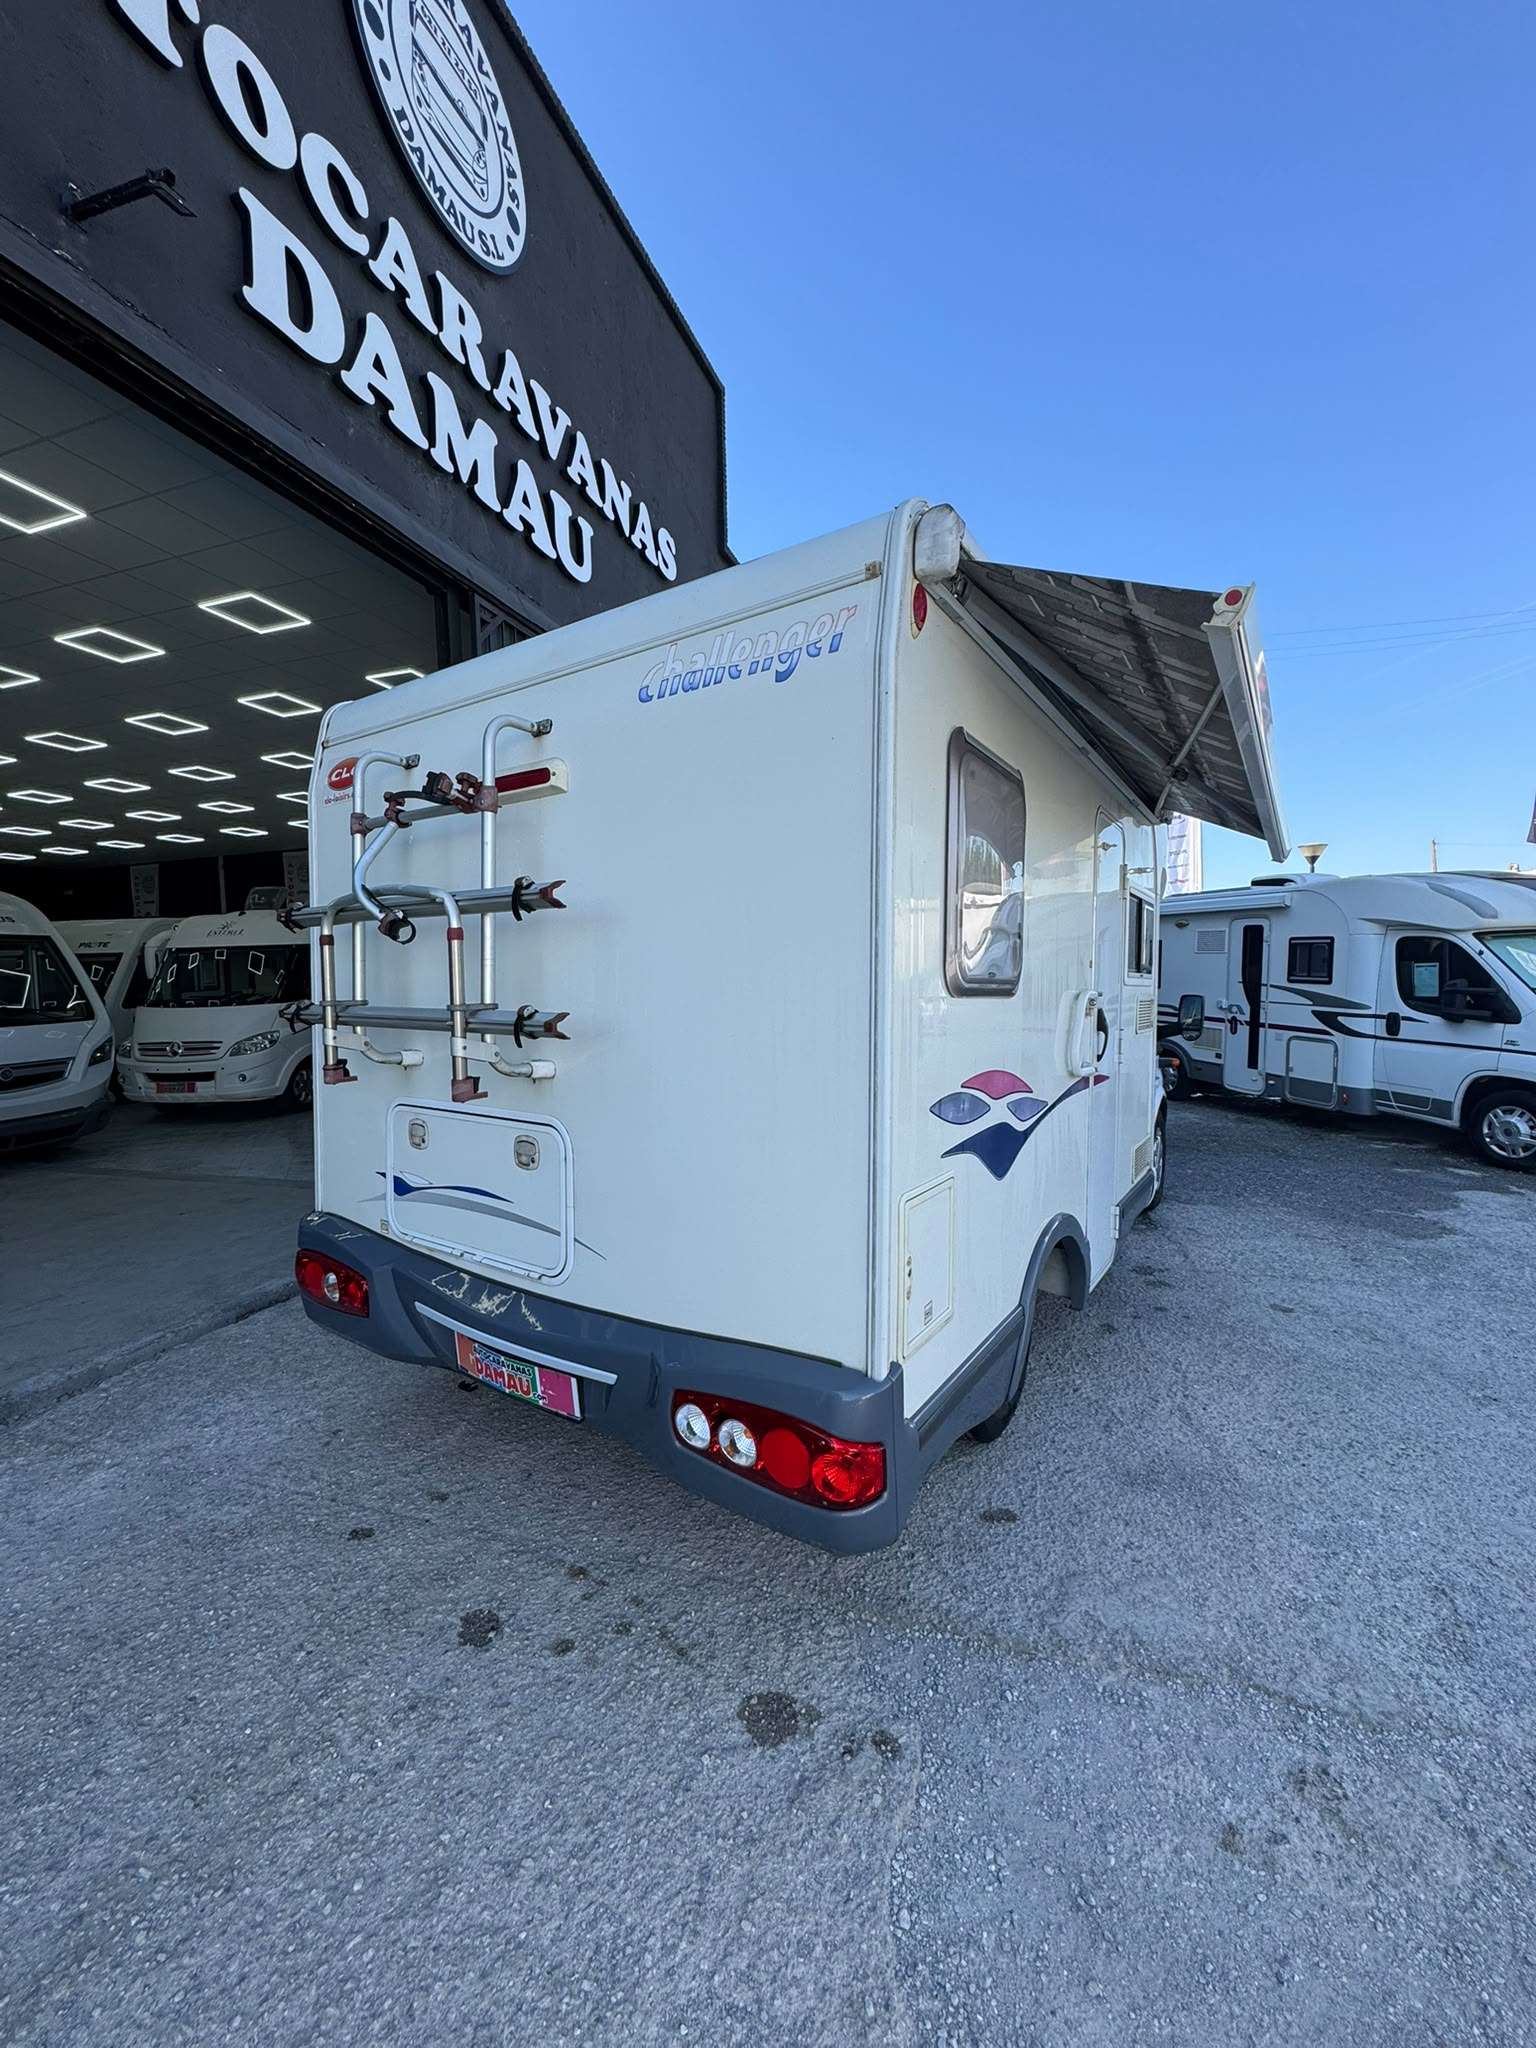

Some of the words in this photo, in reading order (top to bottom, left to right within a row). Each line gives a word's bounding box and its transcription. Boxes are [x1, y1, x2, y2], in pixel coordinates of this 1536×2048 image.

[393, 106, 475, 245] DAMAU
[239, 187, 593, 583] DAMAU
[638, 604, 858, 703] challenger
[474, 1355, 532, 1397] DAMAU
